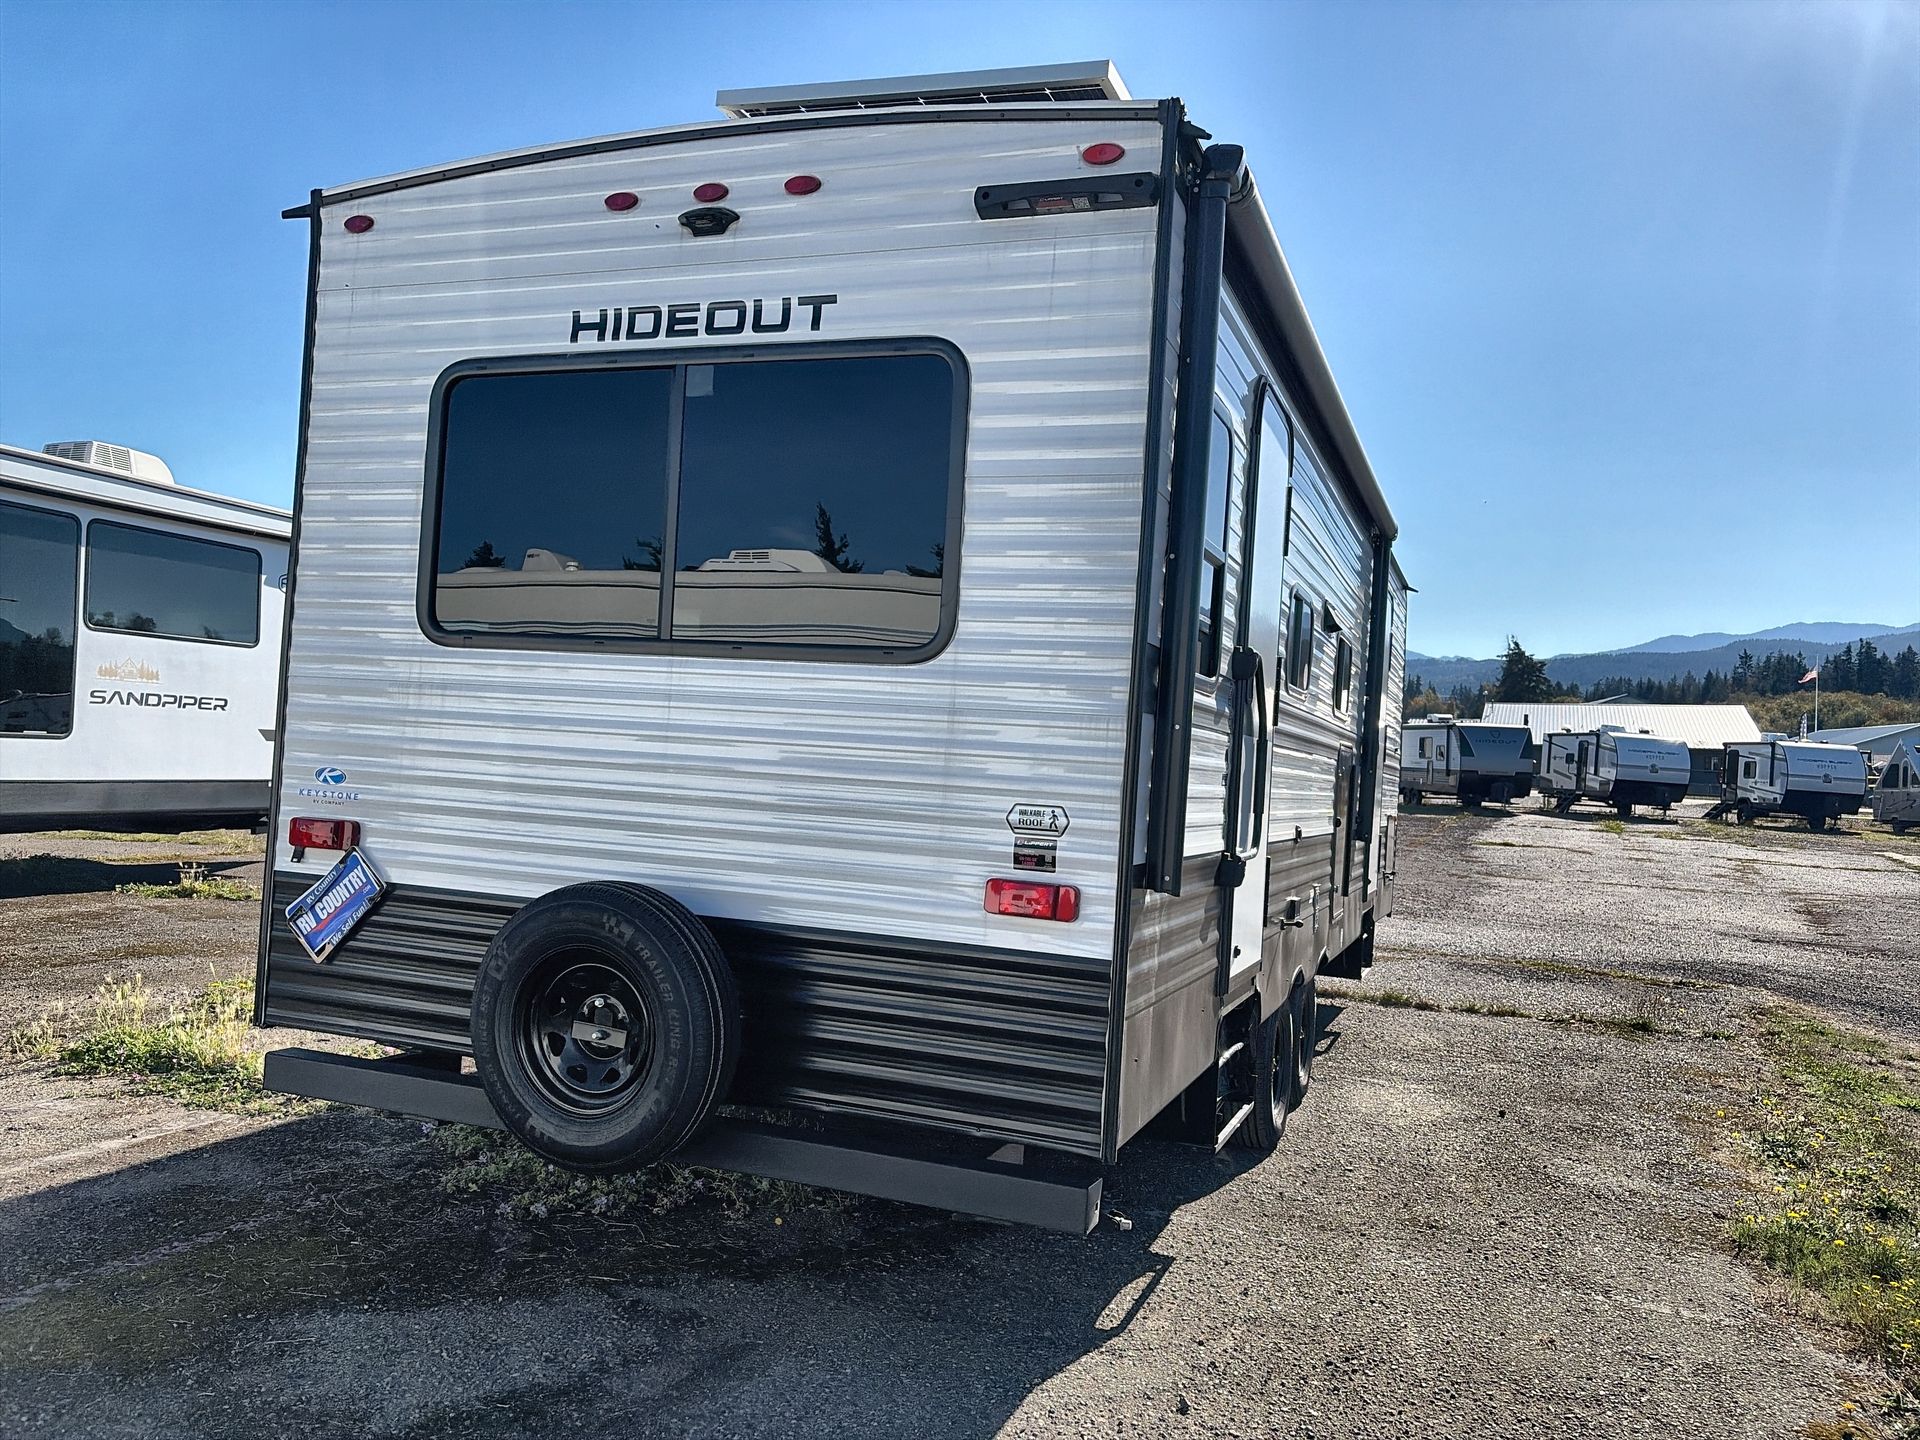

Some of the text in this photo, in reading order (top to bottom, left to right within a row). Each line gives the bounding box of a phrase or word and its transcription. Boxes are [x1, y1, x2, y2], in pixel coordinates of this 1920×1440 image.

[570, 294, 838, 343] HIDEOUT
[89, 689, 228, 711] SANDPIPER
[299, 788, 359, 800] KEYSTONE
[1018, 808, 1046, 817] WALKABLE
[1018, 818, 1045, 827] ROOF
[295, 865, 367, 935] RV COUNTRY
[306, 869, 337, 905] RV Country
[330, 931, 342, 946] We
[341, 916, 354, 931] Sell
[634, 942, 674, 1001] TRAILER
[667, 1008, 682, 1050] KING
